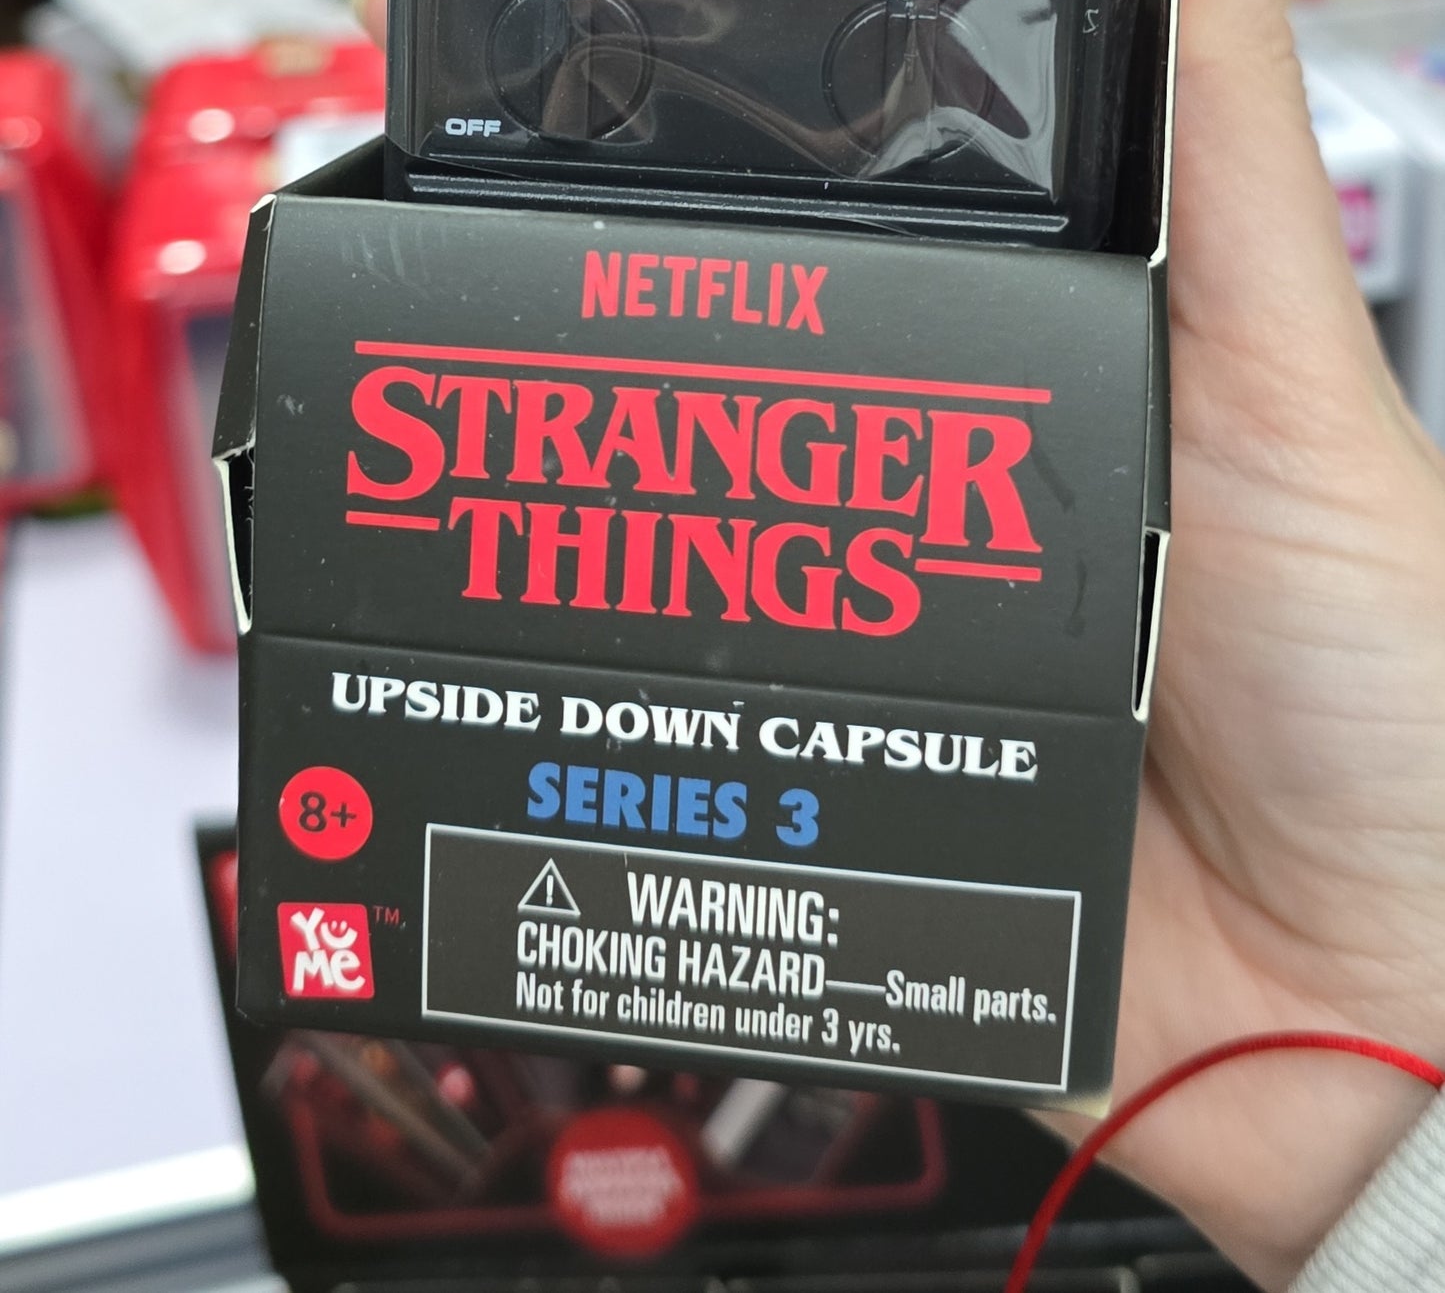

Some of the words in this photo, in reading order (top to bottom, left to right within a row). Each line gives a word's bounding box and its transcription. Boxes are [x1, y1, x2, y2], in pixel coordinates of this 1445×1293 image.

[443, 117, 503, 140] OFF
[580, 250, 829, 334] NETFLIX
[346, 366, 1043, 553] STRANGER
[448, 497, 923, 637] THINGS
[330, 671, 540, 732] UPSIDE
[560, 695, 742, 752] DOWN
[757, 717, 1041, 783] CAPSULE
[299, 791, 357, 833] 8+
[526, 762, 748, 839] SERIES
[775, 787, 821, 847] 3
[626, 871, 839, 947] WARNING:
[515, 971, 565, 1014] Not
[571, 978, 611, 1020] for
[616, 985, 726, 1034] children
[734, 1002, 814, 1048] under
[821, 1007, 840, 1047] 3
[848, 1019, 901, 1057] yrs.
[517, 920, 667, 983] CHOKING
[972, 987, 1058, 1027] parts.
